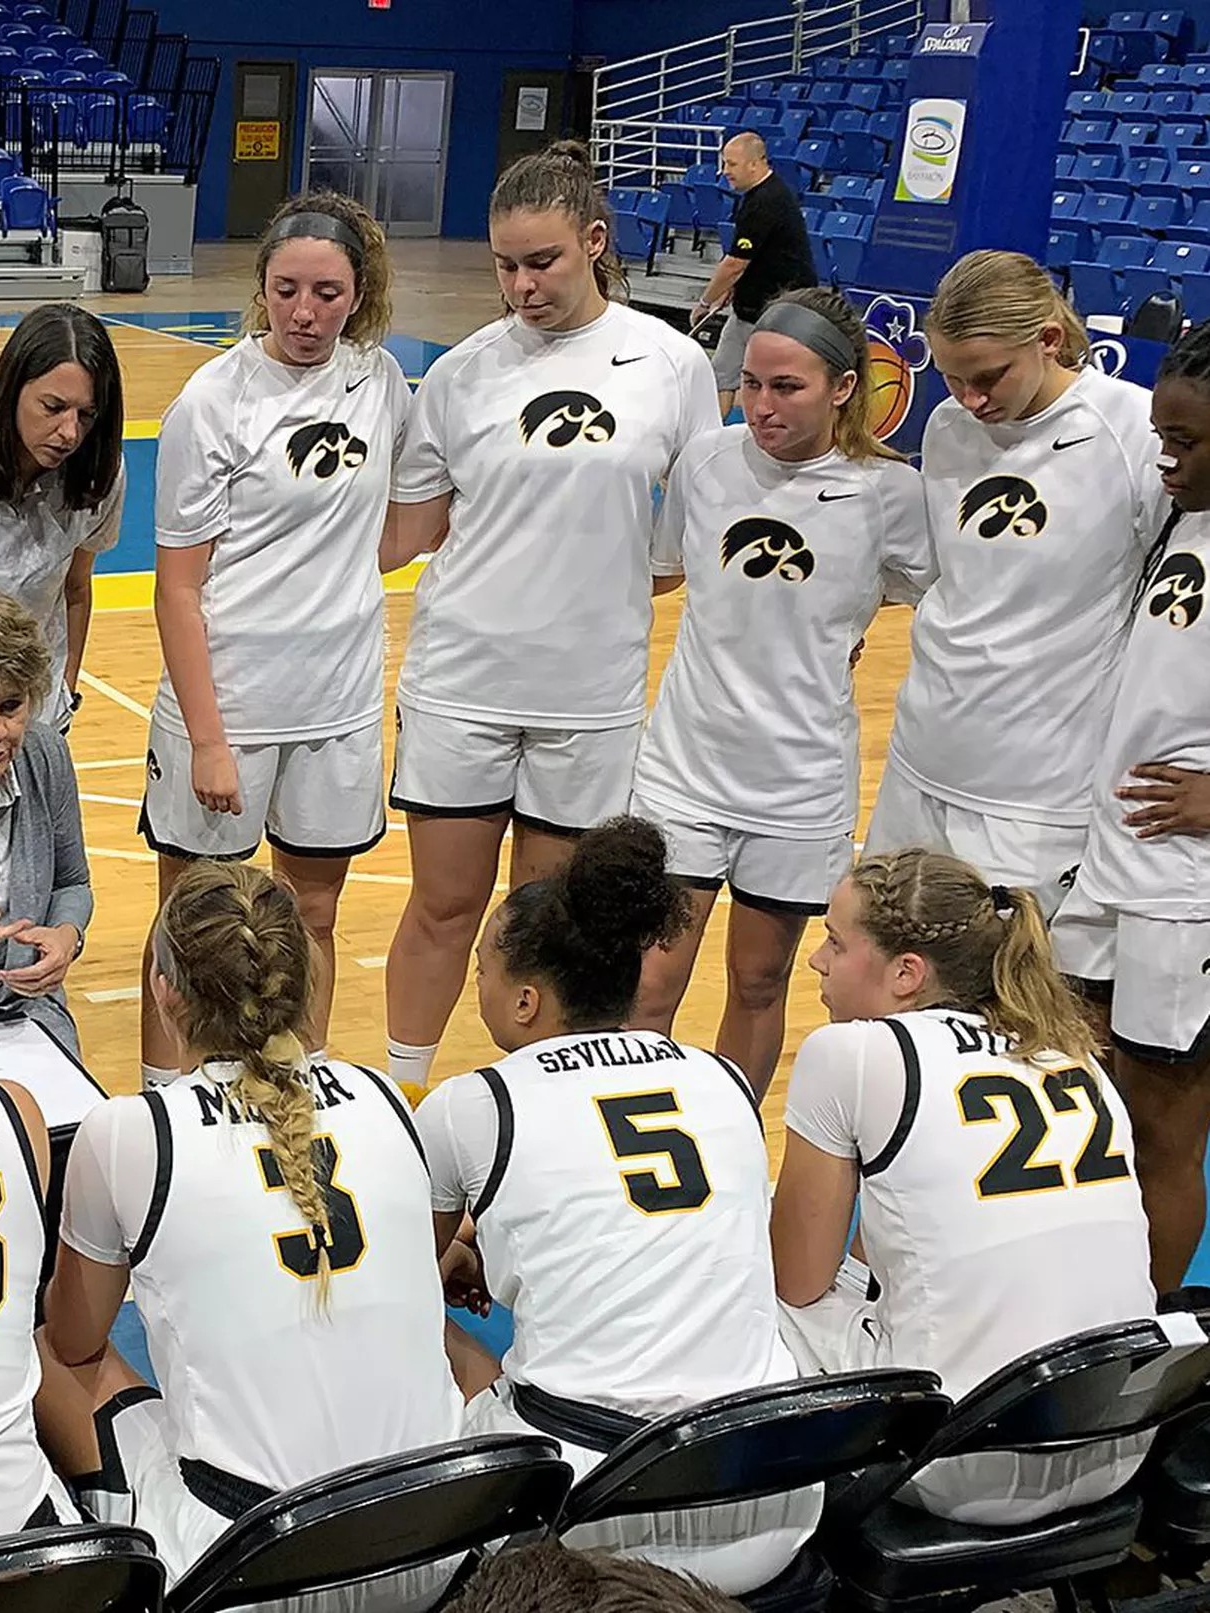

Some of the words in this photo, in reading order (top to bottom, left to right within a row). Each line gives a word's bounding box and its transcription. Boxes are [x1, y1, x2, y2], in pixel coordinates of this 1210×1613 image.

[920, 35, 973, 53] SPALDING
[593, 1088, 714, 1216] 5
[955, 1065, 1131, 1200] 22
[253, 1133, 366, 1281] 3
